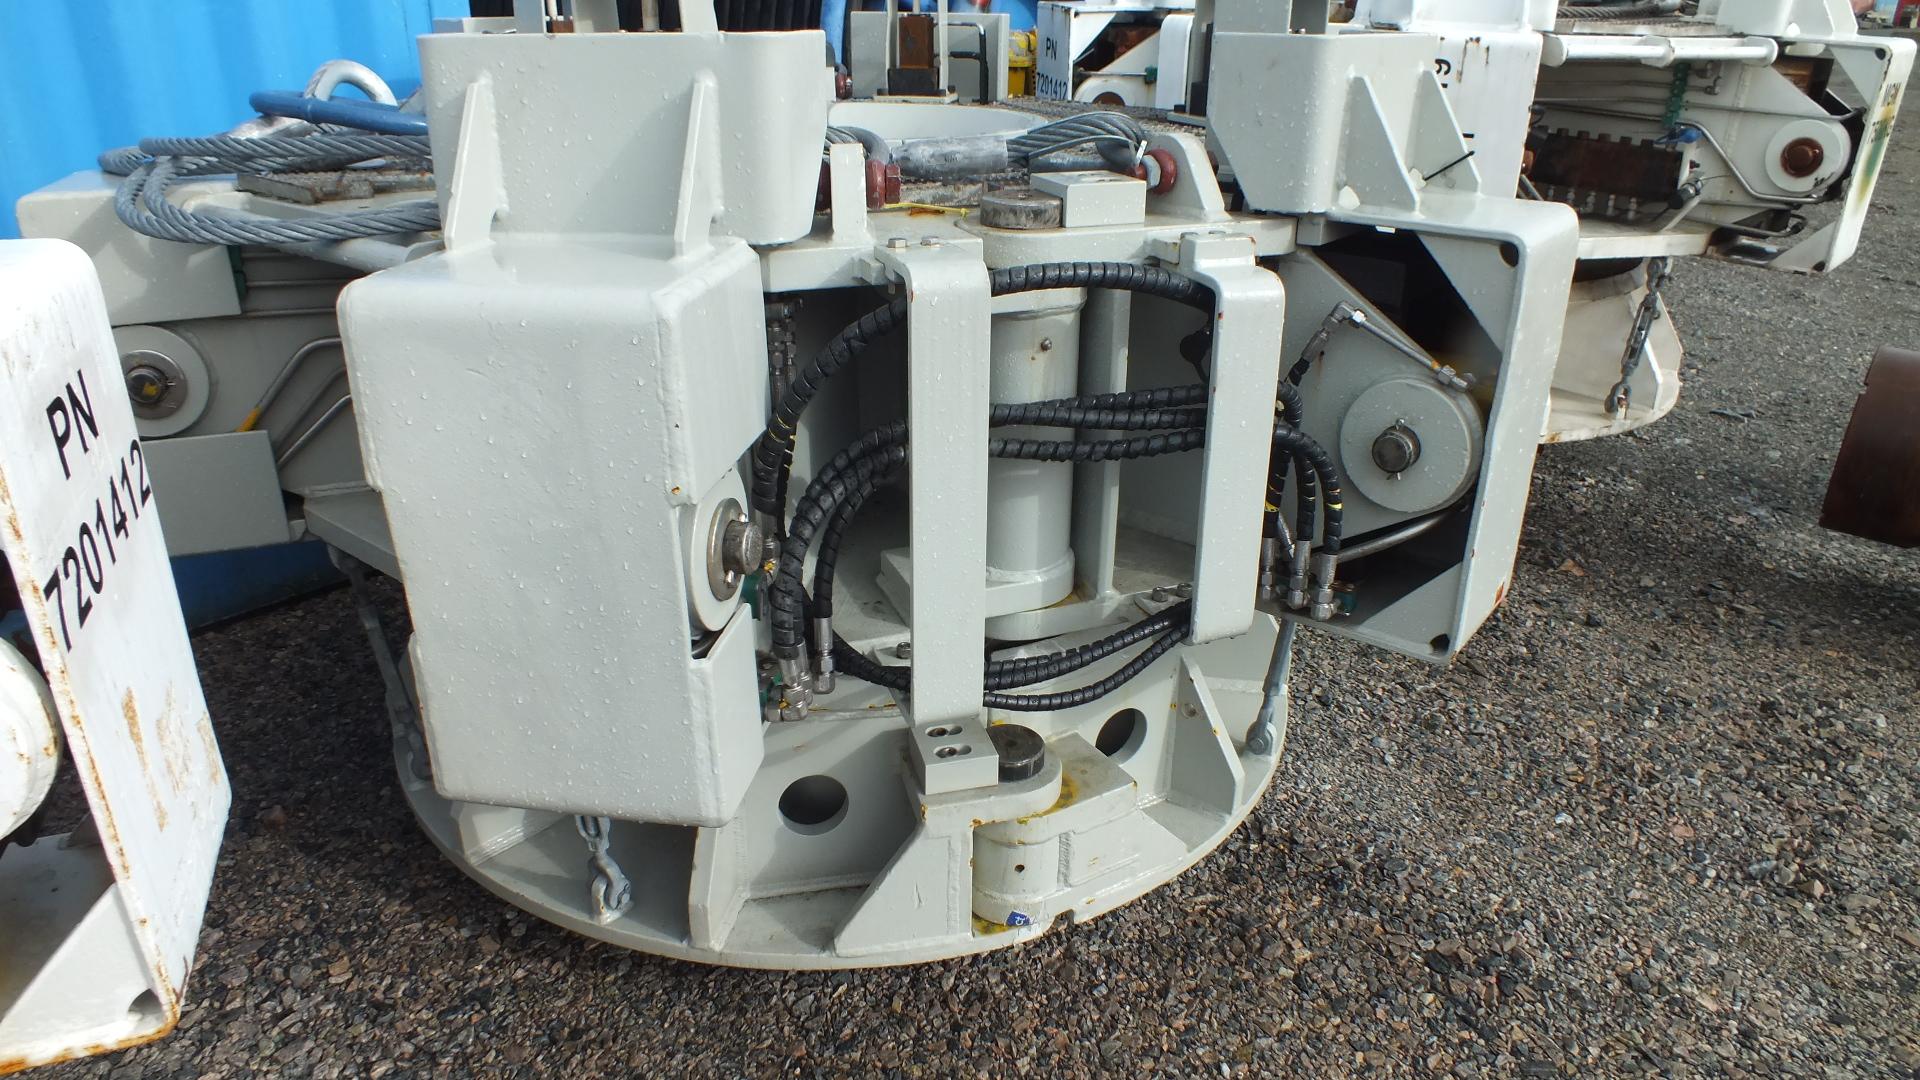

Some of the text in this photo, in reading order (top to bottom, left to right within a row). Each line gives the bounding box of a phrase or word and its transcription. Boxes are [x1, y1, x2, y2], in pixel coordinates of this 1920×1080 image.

[1045, 36, 1058, 60] PN
[46, 368, 99, 480] PN
[43, 439, 151, 652] 7201412
